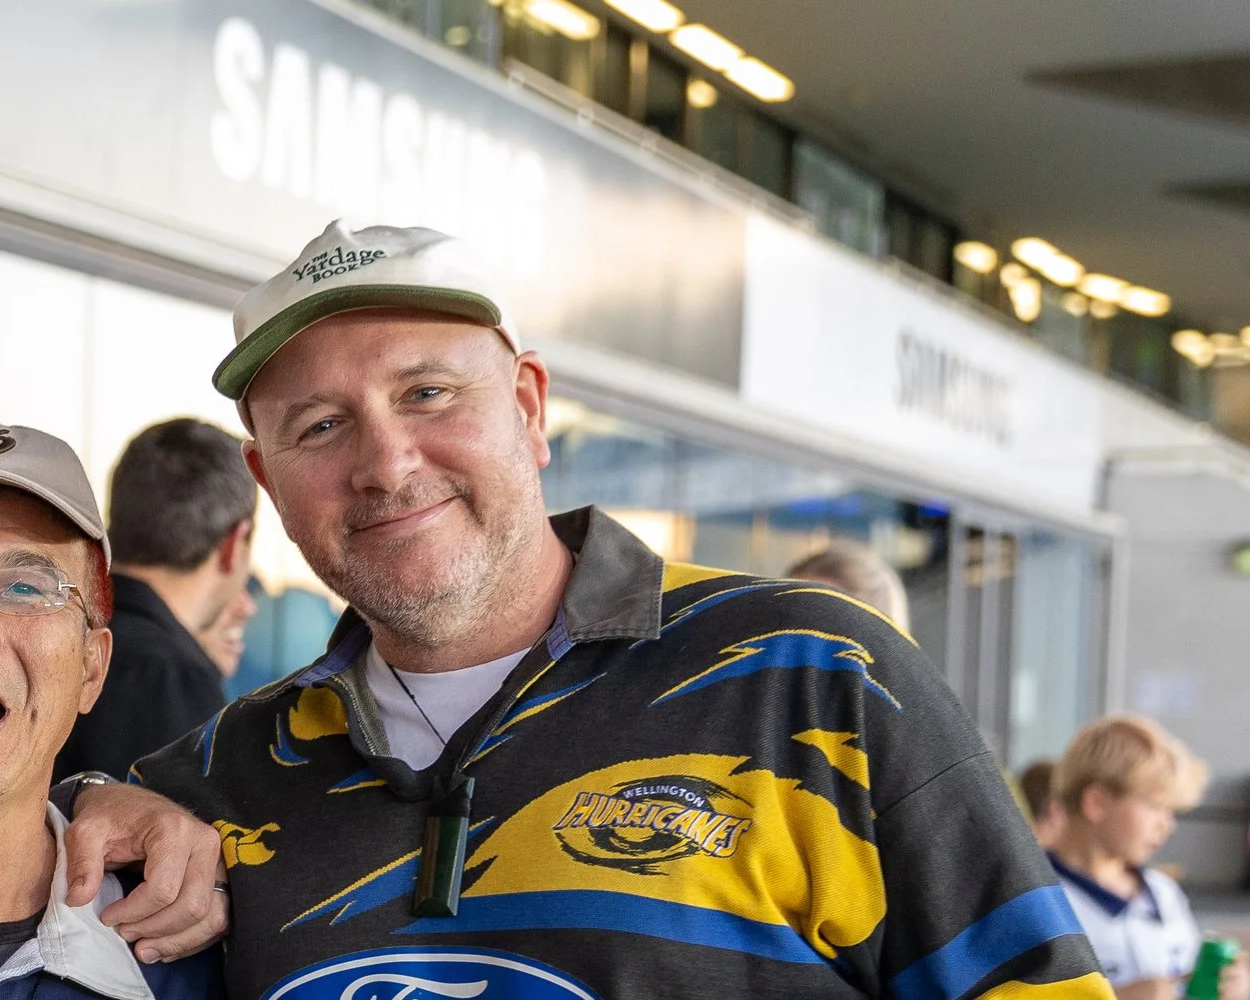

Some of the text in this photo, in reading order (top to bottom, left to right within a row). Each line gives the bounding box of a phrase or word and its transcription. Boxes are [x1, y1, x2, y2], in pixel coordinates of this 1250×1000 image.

[292, 246, 387, 281] Yardage
[312, 263, 360, 284] BOOK
[623, 785, 705, 807] WELLINGTON
[553, 791, 752, 858] HURRICANES
